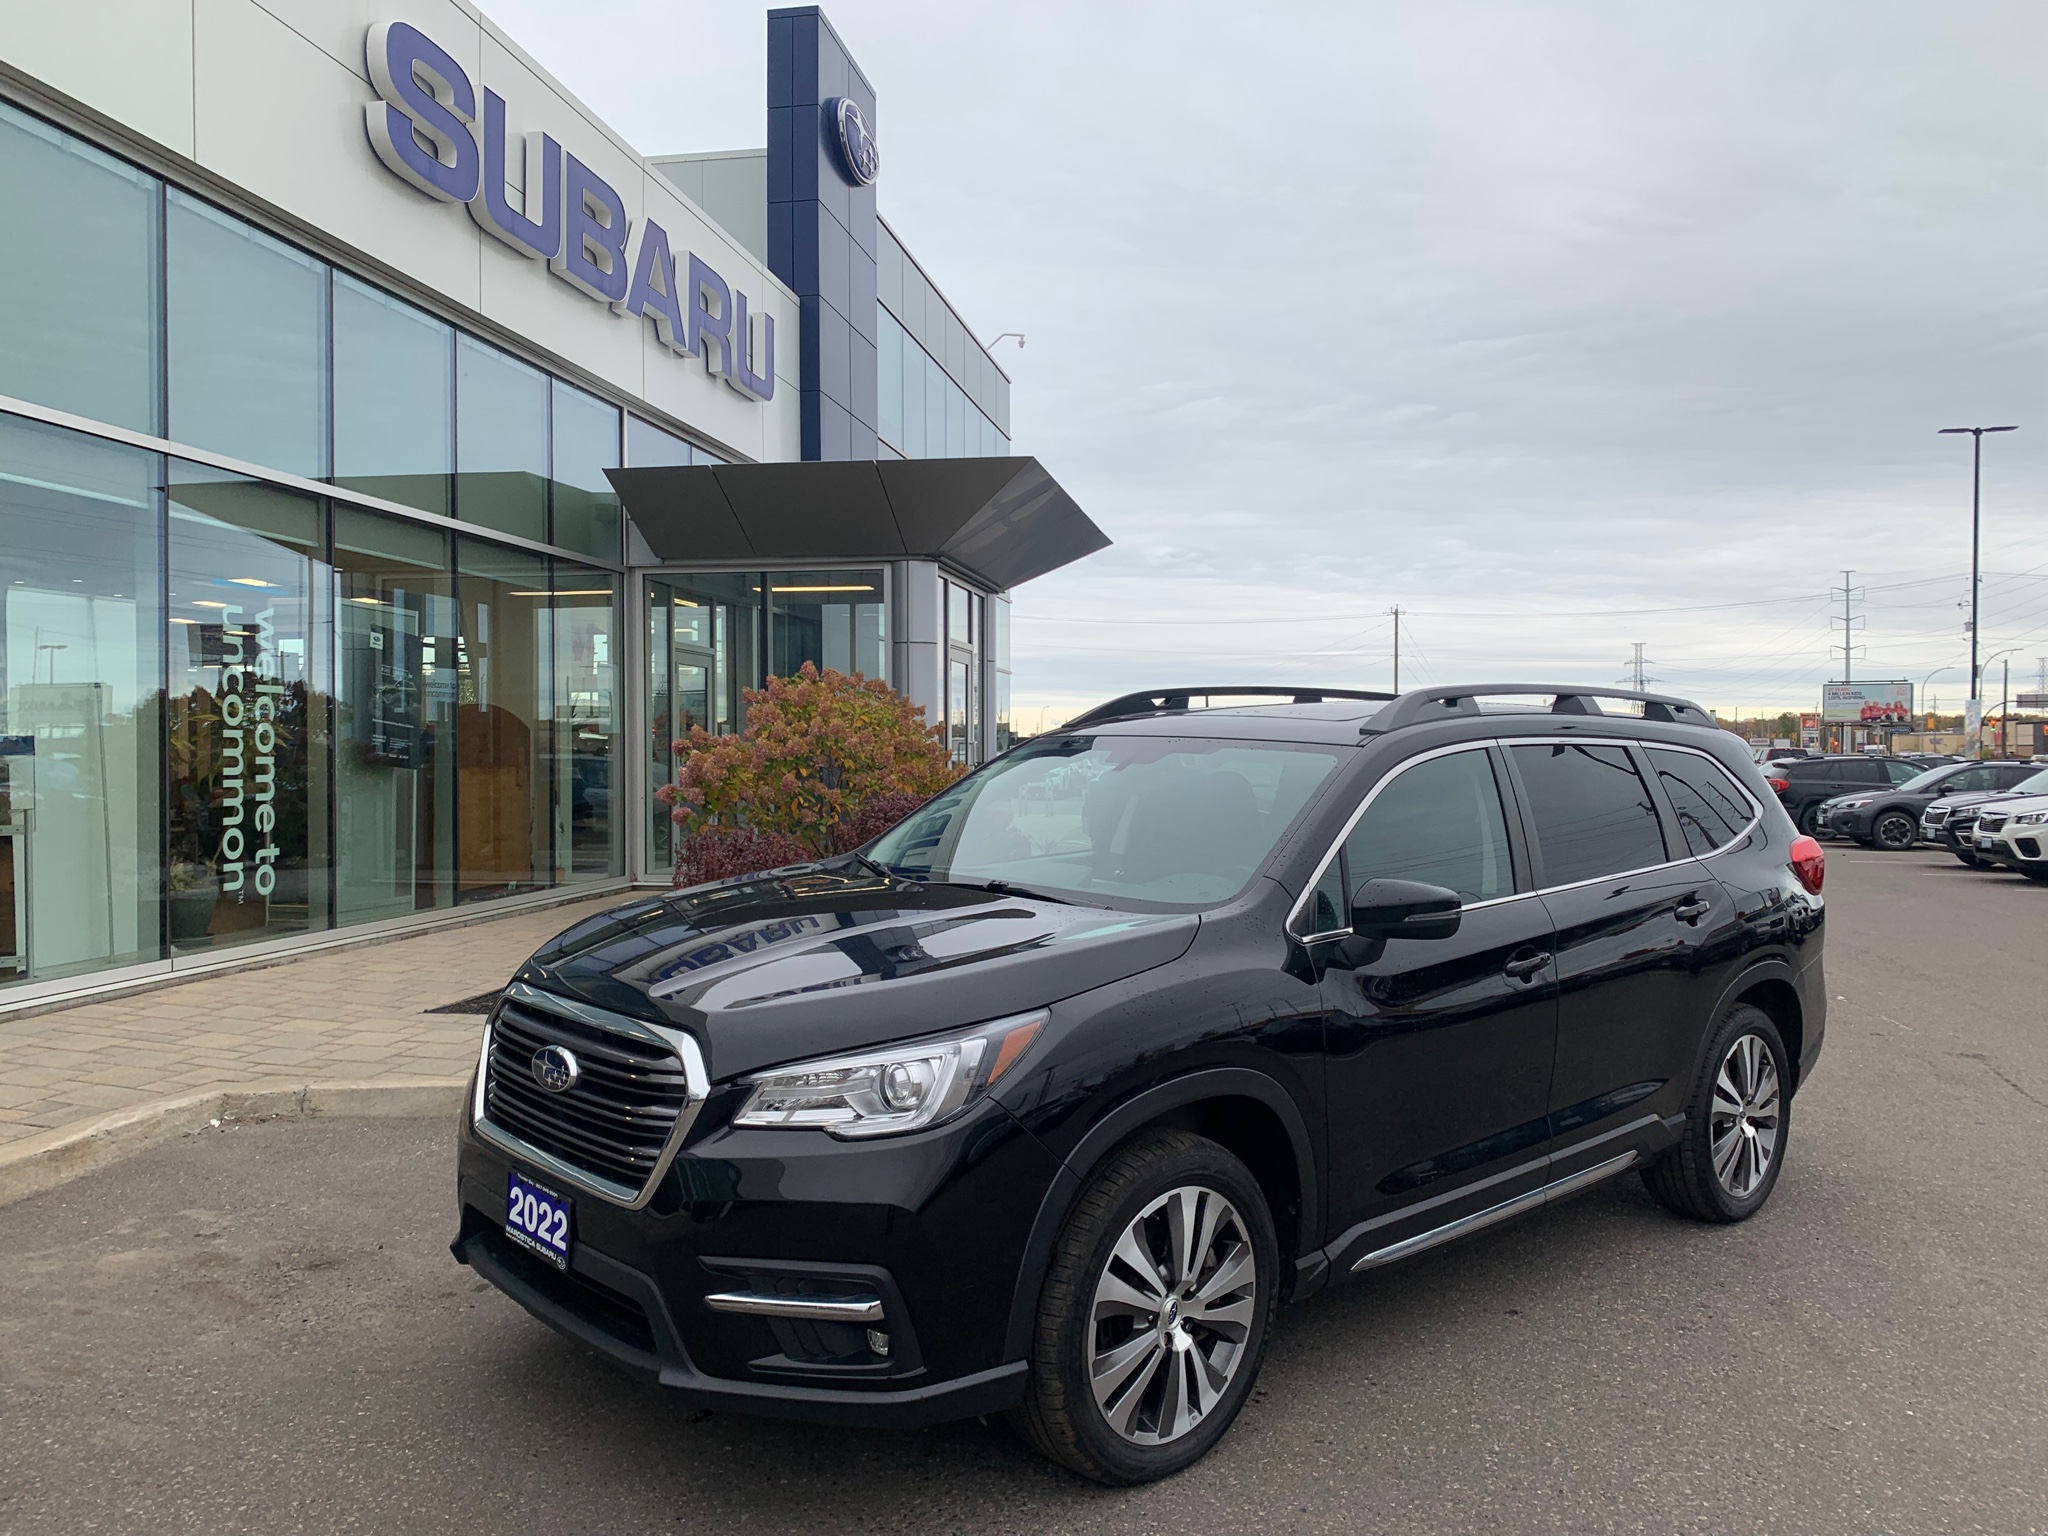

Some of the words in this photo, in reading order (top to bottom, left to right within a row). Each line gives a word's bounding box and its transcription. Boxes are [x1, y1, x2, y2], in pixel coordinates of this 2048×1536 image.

[365, 21, 774, 402] SUBARU
[255, 607, 285, 834] welcome
[255, 843, 281, 896] to
[505, 1224, 536, 1249] MAROSTICA
[535, 1243, 557, 1261] SUBARU
[509, 1186, 568, 1252] 2022
